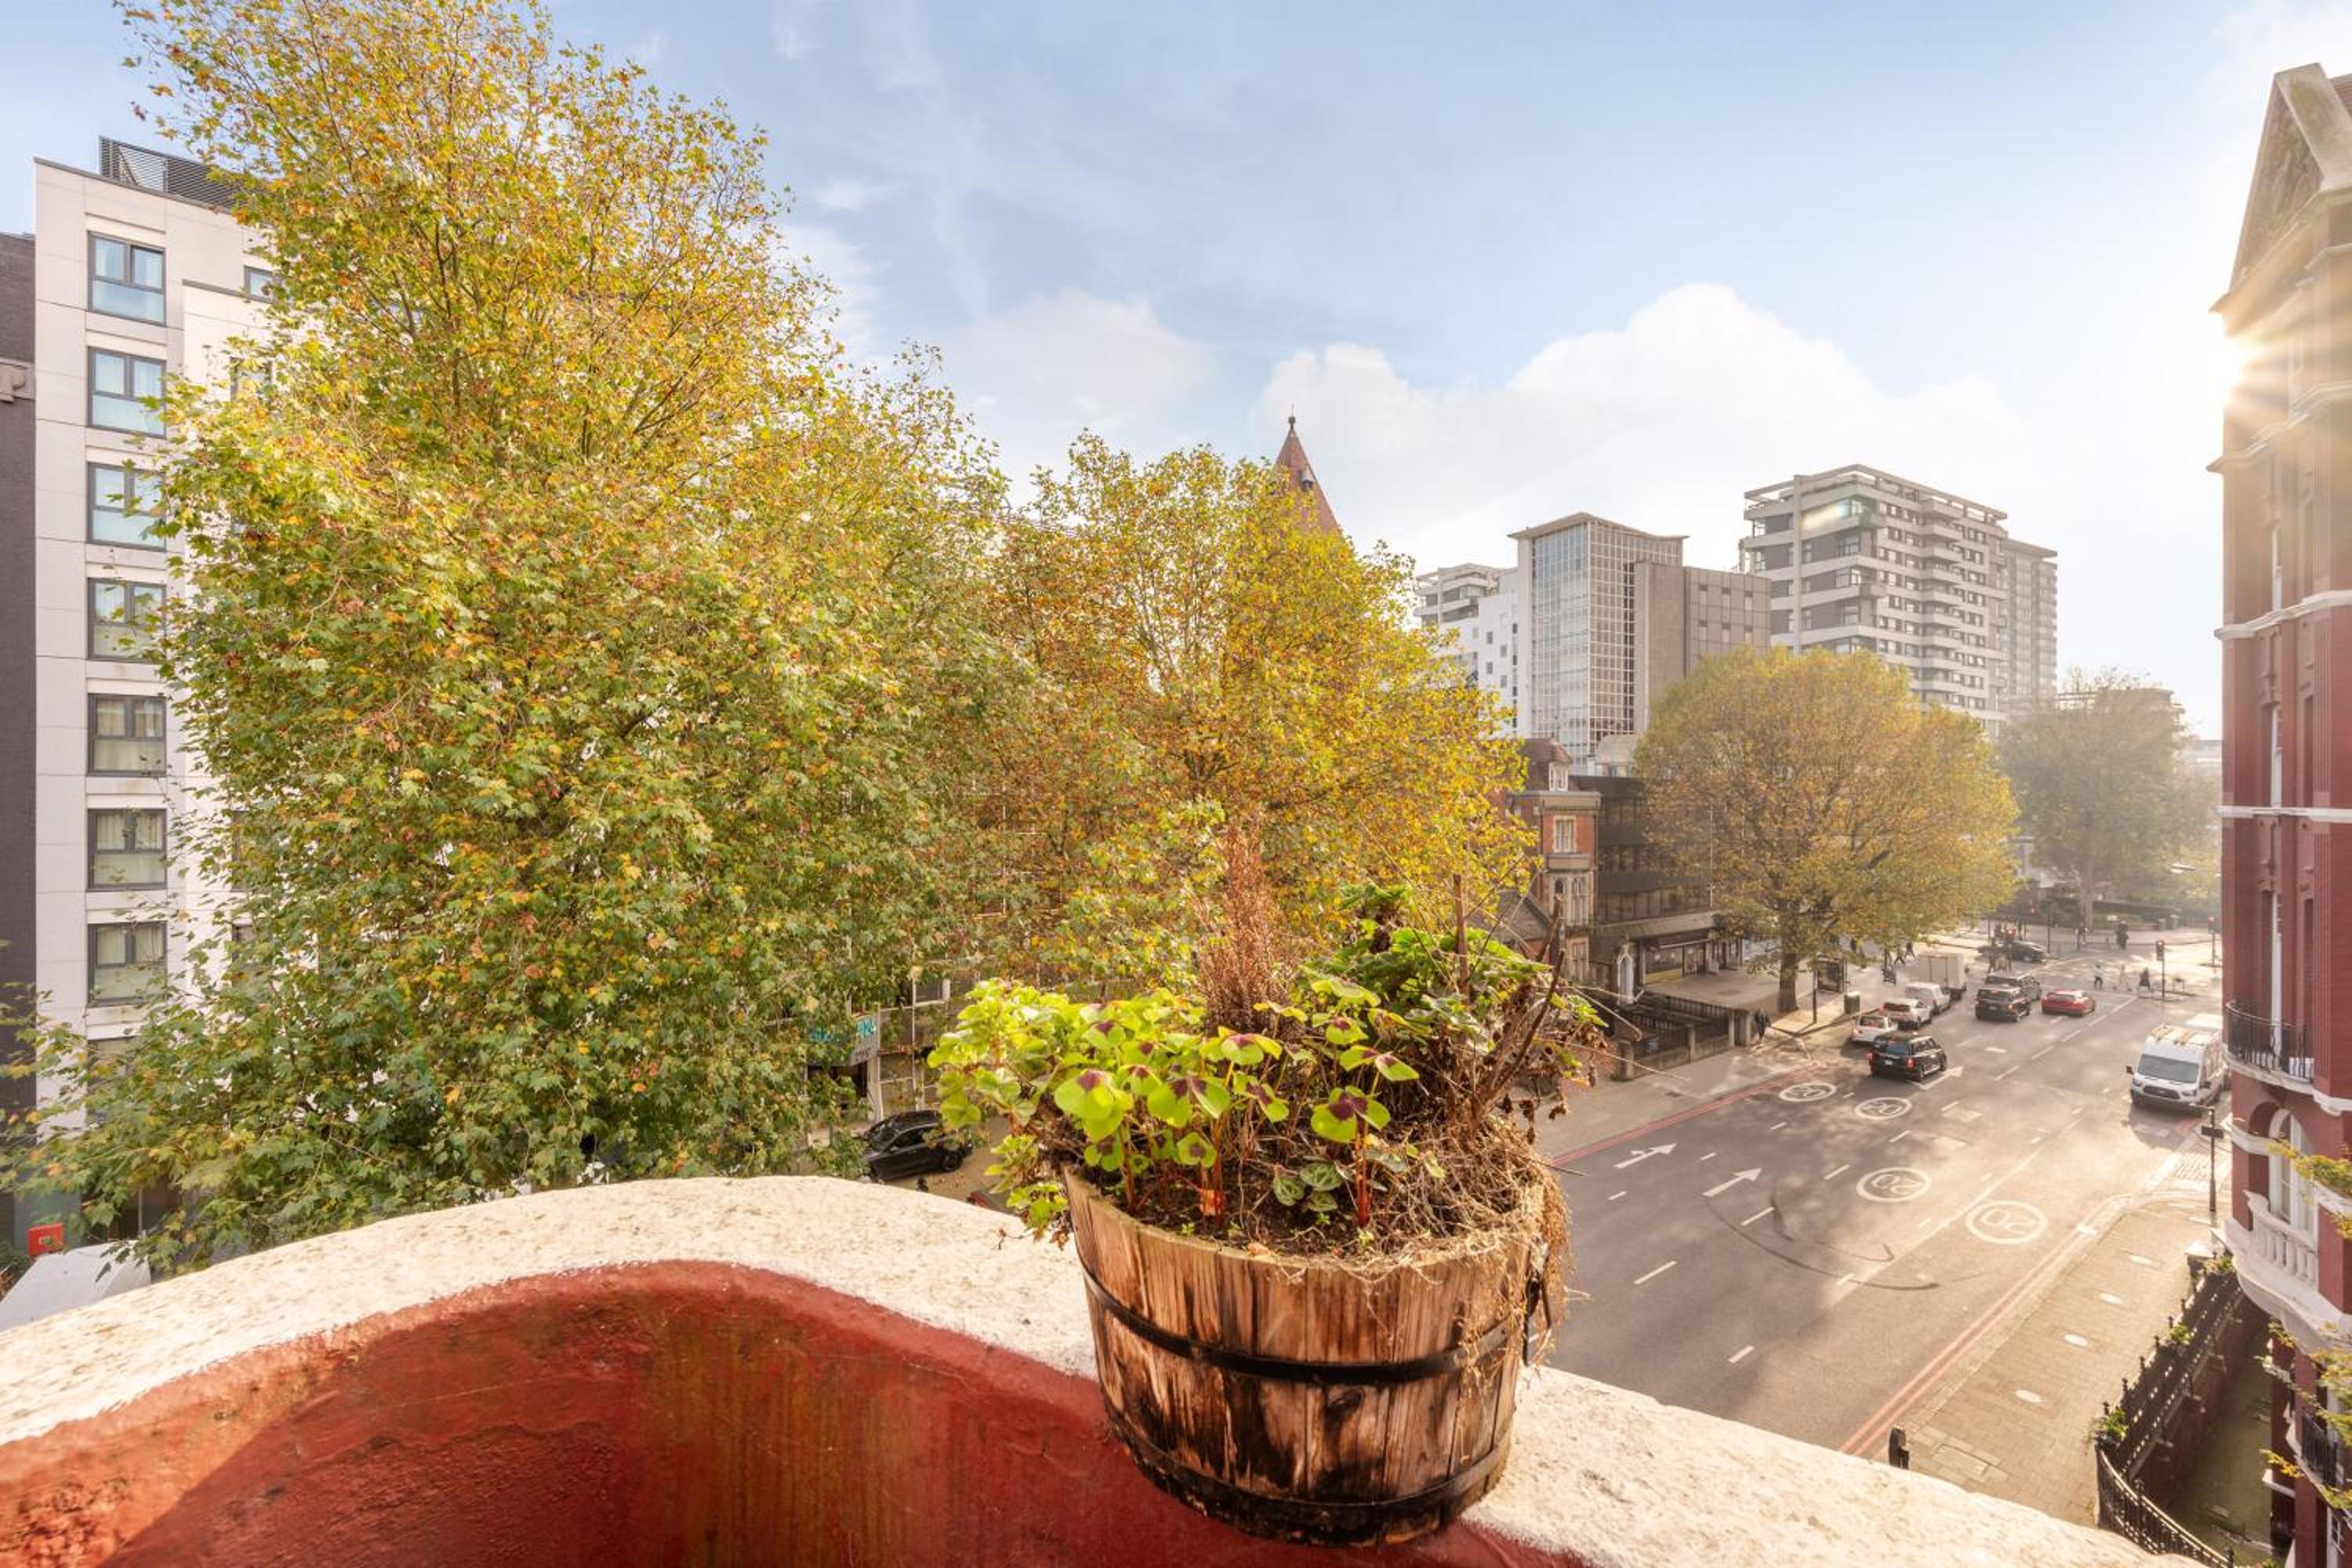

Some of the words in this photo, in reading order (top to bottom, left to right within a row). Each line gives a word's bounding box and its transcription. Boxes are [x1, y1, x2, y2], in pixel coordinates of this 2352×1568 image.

[1863, 1101, 1903, 1116] 20
[1871, 1174, 1923, 1195] 20
[1980, 1208, 2036, 1234] 20
